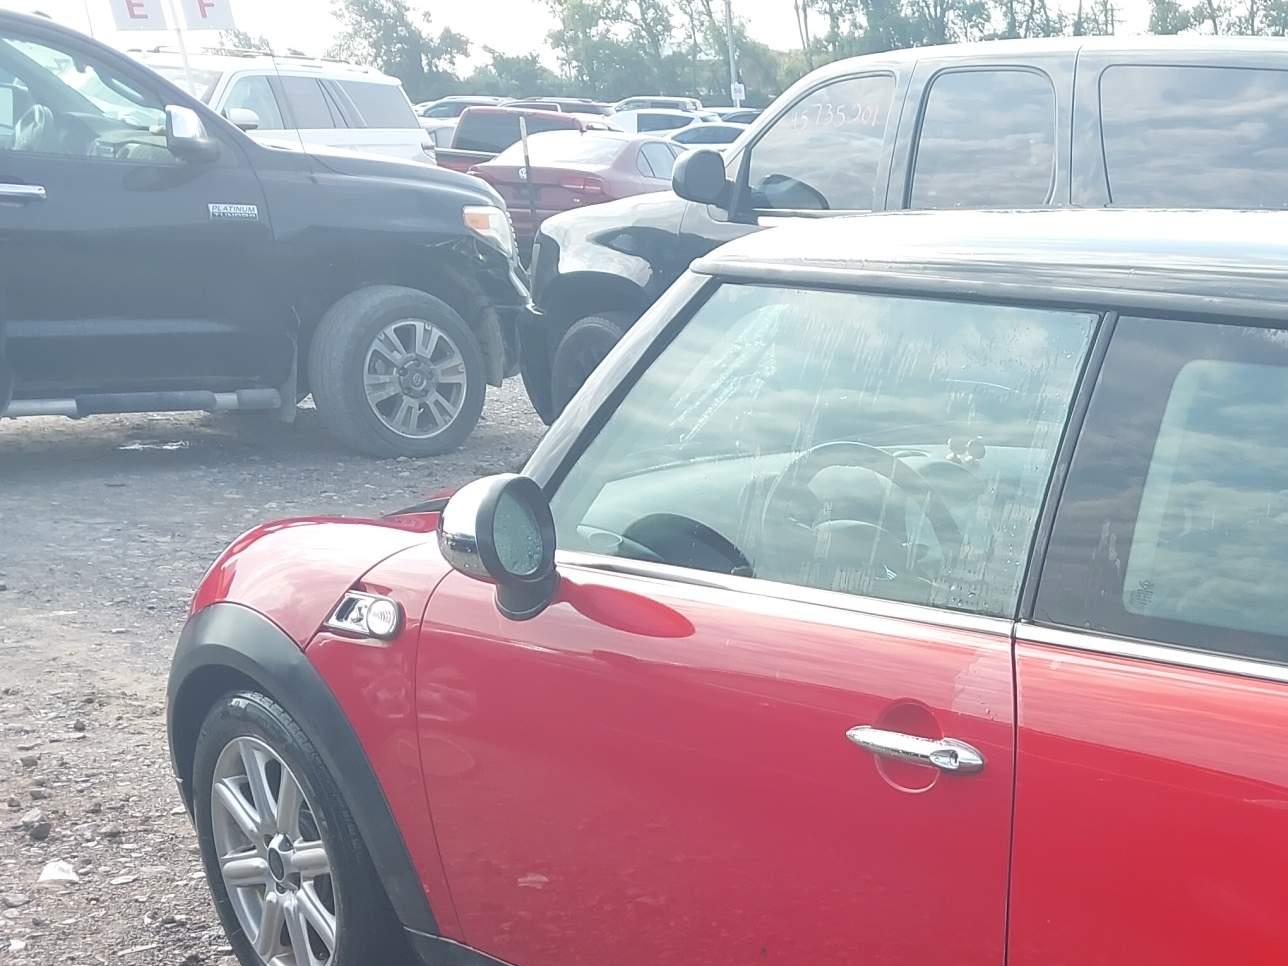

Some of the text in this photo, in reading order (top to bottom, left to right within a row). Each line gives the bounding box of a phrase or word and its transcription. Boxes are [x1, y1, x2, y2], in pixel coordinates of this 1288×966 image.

[126, 0, 148, 19] E
[198, 0, 215, 18] F
[211, 205, 256, 213] PLATINUM
